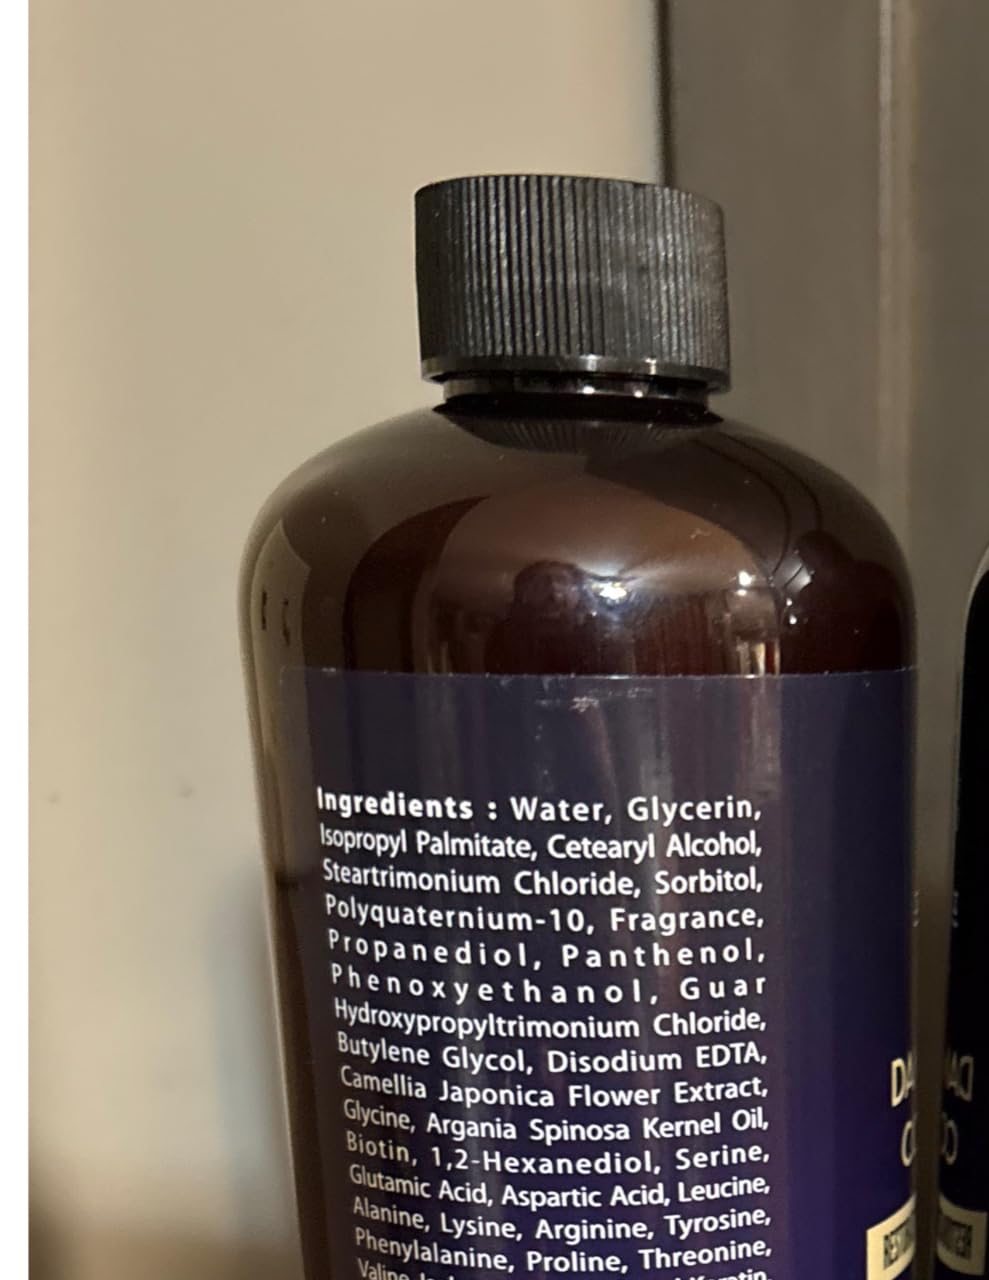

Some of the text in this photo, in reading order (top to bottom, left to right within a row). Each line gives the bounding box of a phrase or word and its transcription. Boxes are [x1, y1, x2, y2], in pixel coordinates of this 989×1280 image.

[317, 786, 761, 827] Ingredients Water, Glycerin,
[320, 823, 762, 864] Isopropyl Palmitate, Cetearyl Alcohol,
[323, 858, 763, 898] Steartrimonium Chloride, Sorbitol,
[325, 893, 764, 936] Polyquaternium-10, Fragrance,
[328, 928, 764, 971] Propanediol, Panthenol,
[331, 963, 766, 1005] Phenoxyethanol, Guar
[334, 997, 766, 1041] Hydroxypropyltrimonium Chloride,
[337, 1031, 767, 1075] Butylene Glycol, Disodium EDTA,
[341, 1065, 768, 1108] Camellia Japonica Flower Extract,
[344, 1098, 769, 1146] Glycine, Argania Spinosa Kernel Oil,
[346, 1130, 770, 1175] Biotin, 1,2-Hexanediol, Serine,
[349, 1164, 770, 1212] Glutamic Acid, Aspartic Acid, Leucine,
[353, 1196, 771, 1246] Alanine, Lysine, Arginine, Tyrosine,
[355, 1227, 772, 1274] Phenylalanine, Proline, Threonine,
